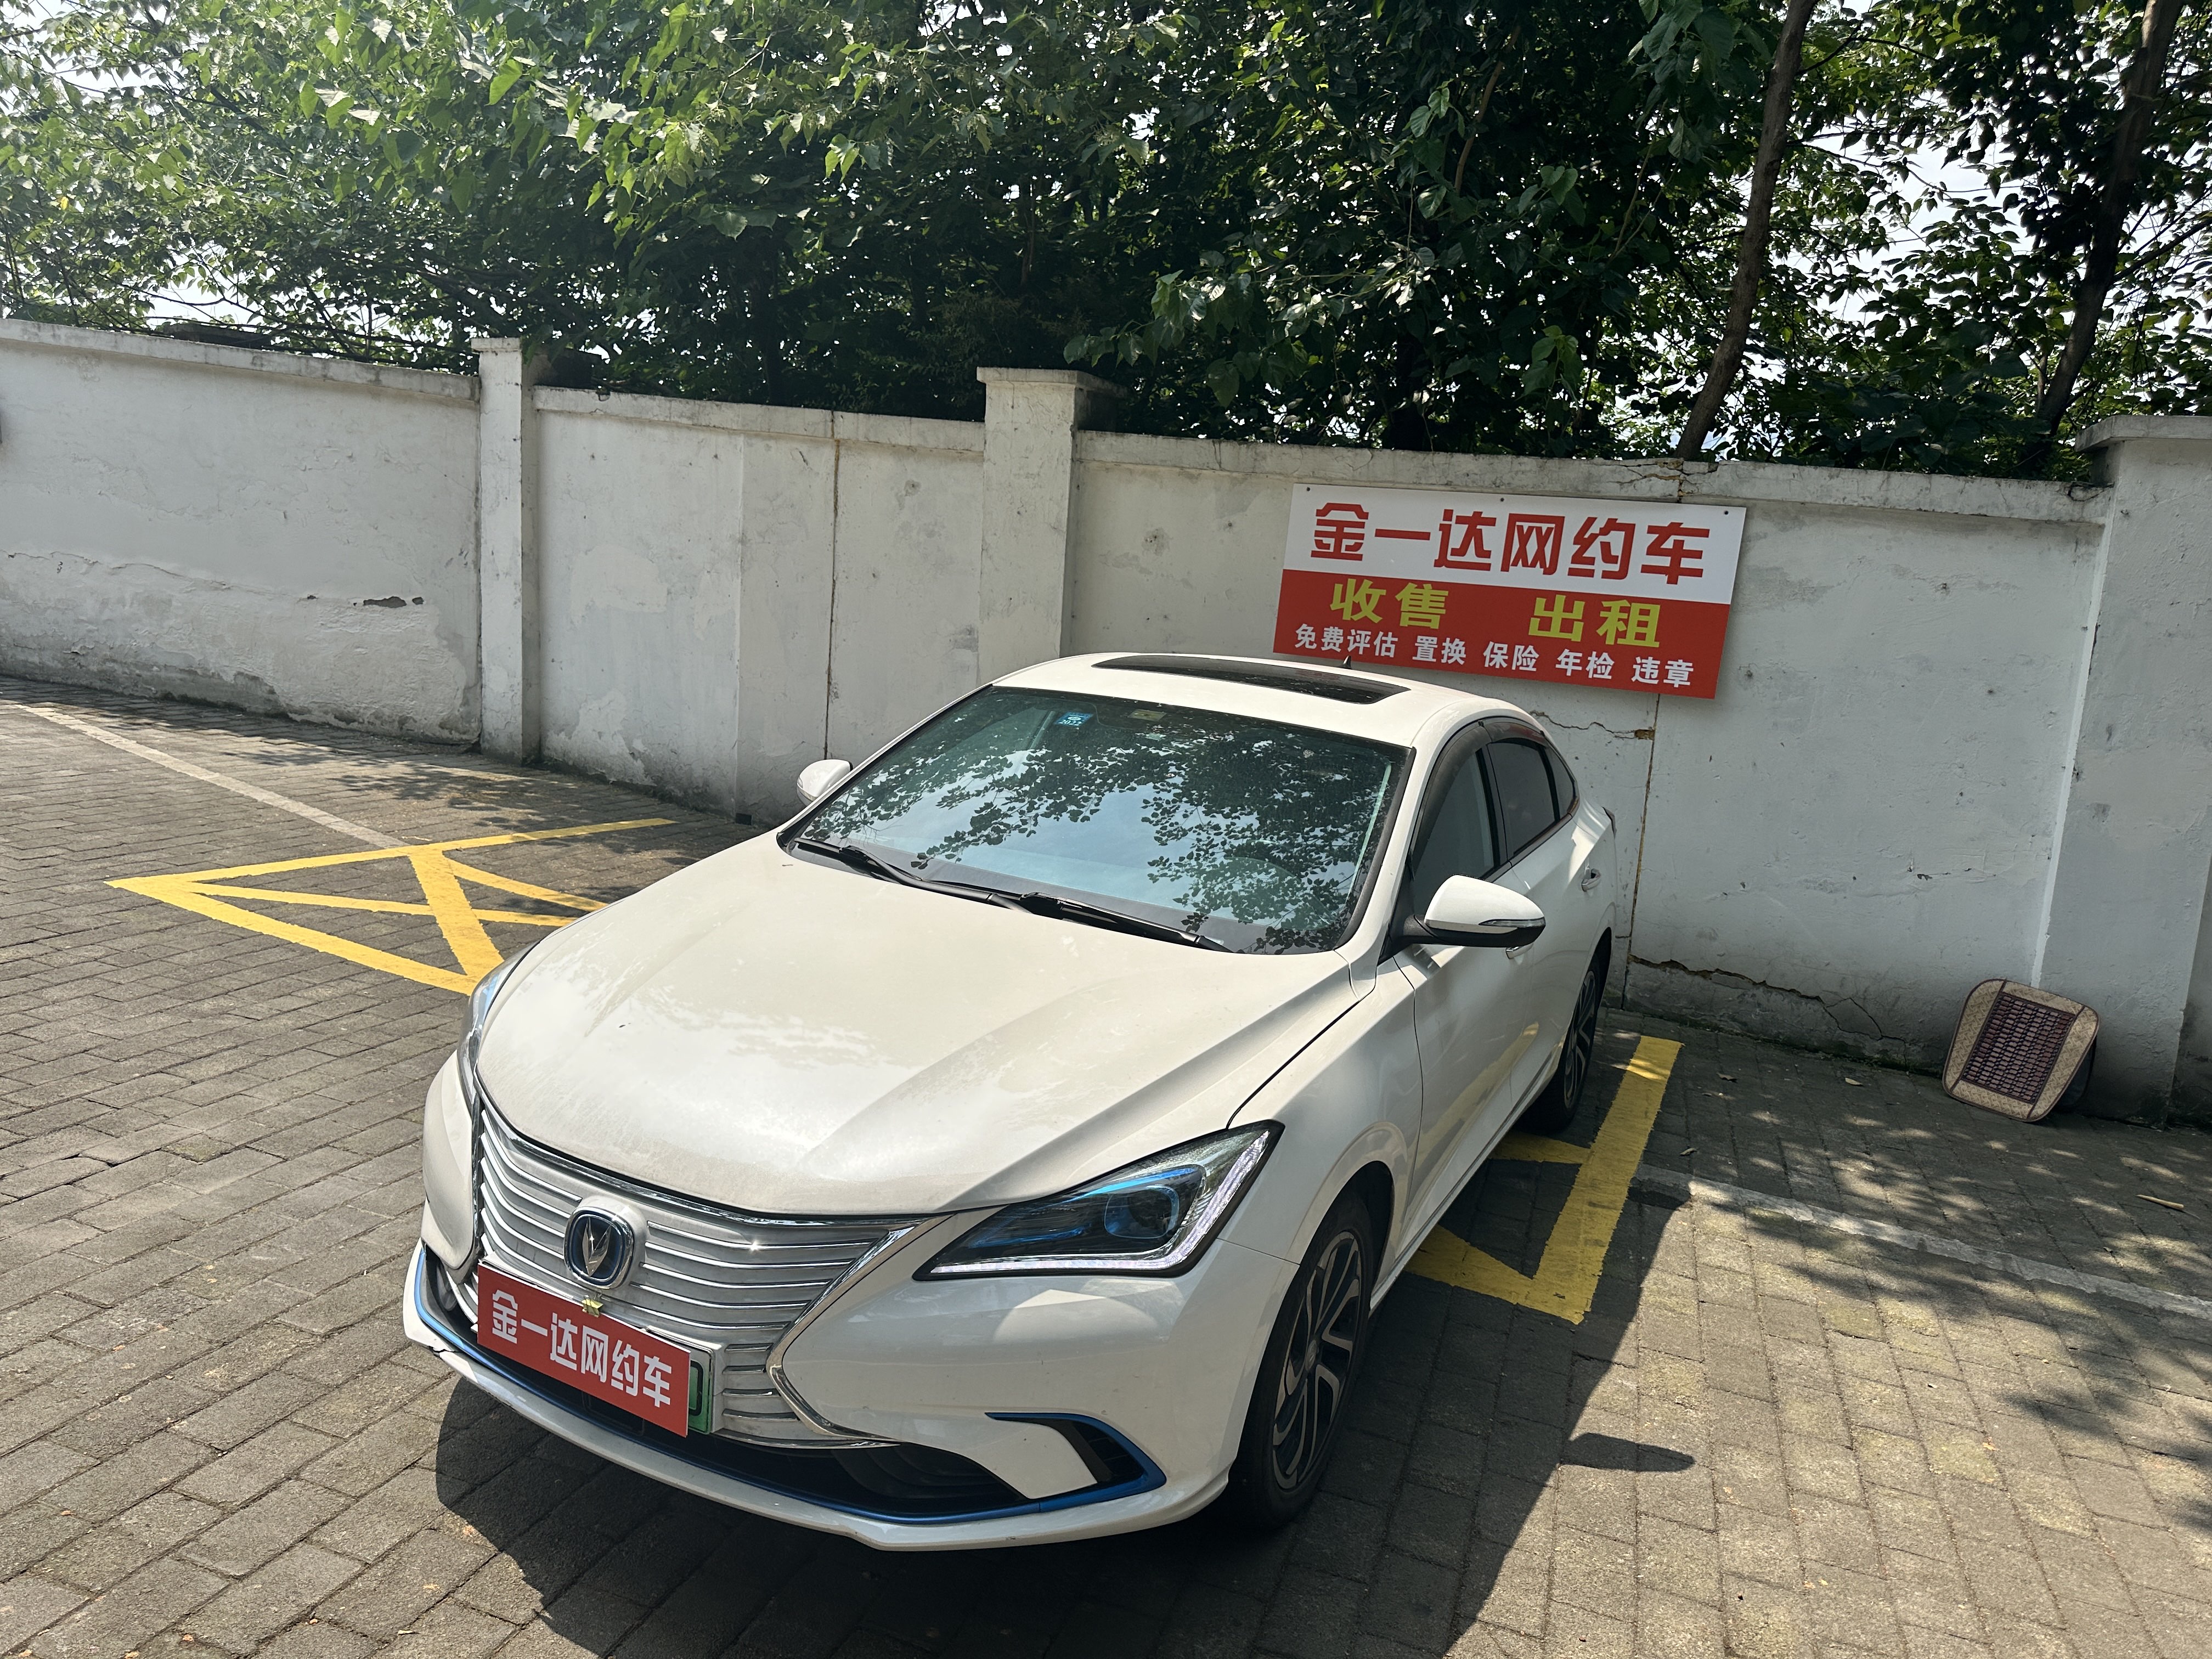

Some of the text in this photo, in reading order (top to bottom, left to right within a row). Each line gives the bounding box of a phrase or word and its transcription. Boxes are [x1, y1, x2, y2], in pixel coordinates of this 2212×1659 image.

[1311, 503, 1710, 585] 金一达网约车
[1330, 578, 1661, 648] 收售 出租
[1295, 623, 1694, 688] 免费评估 置换 保险 年检 违章
[492, 1289, 672, 1408] 金一达网约车
